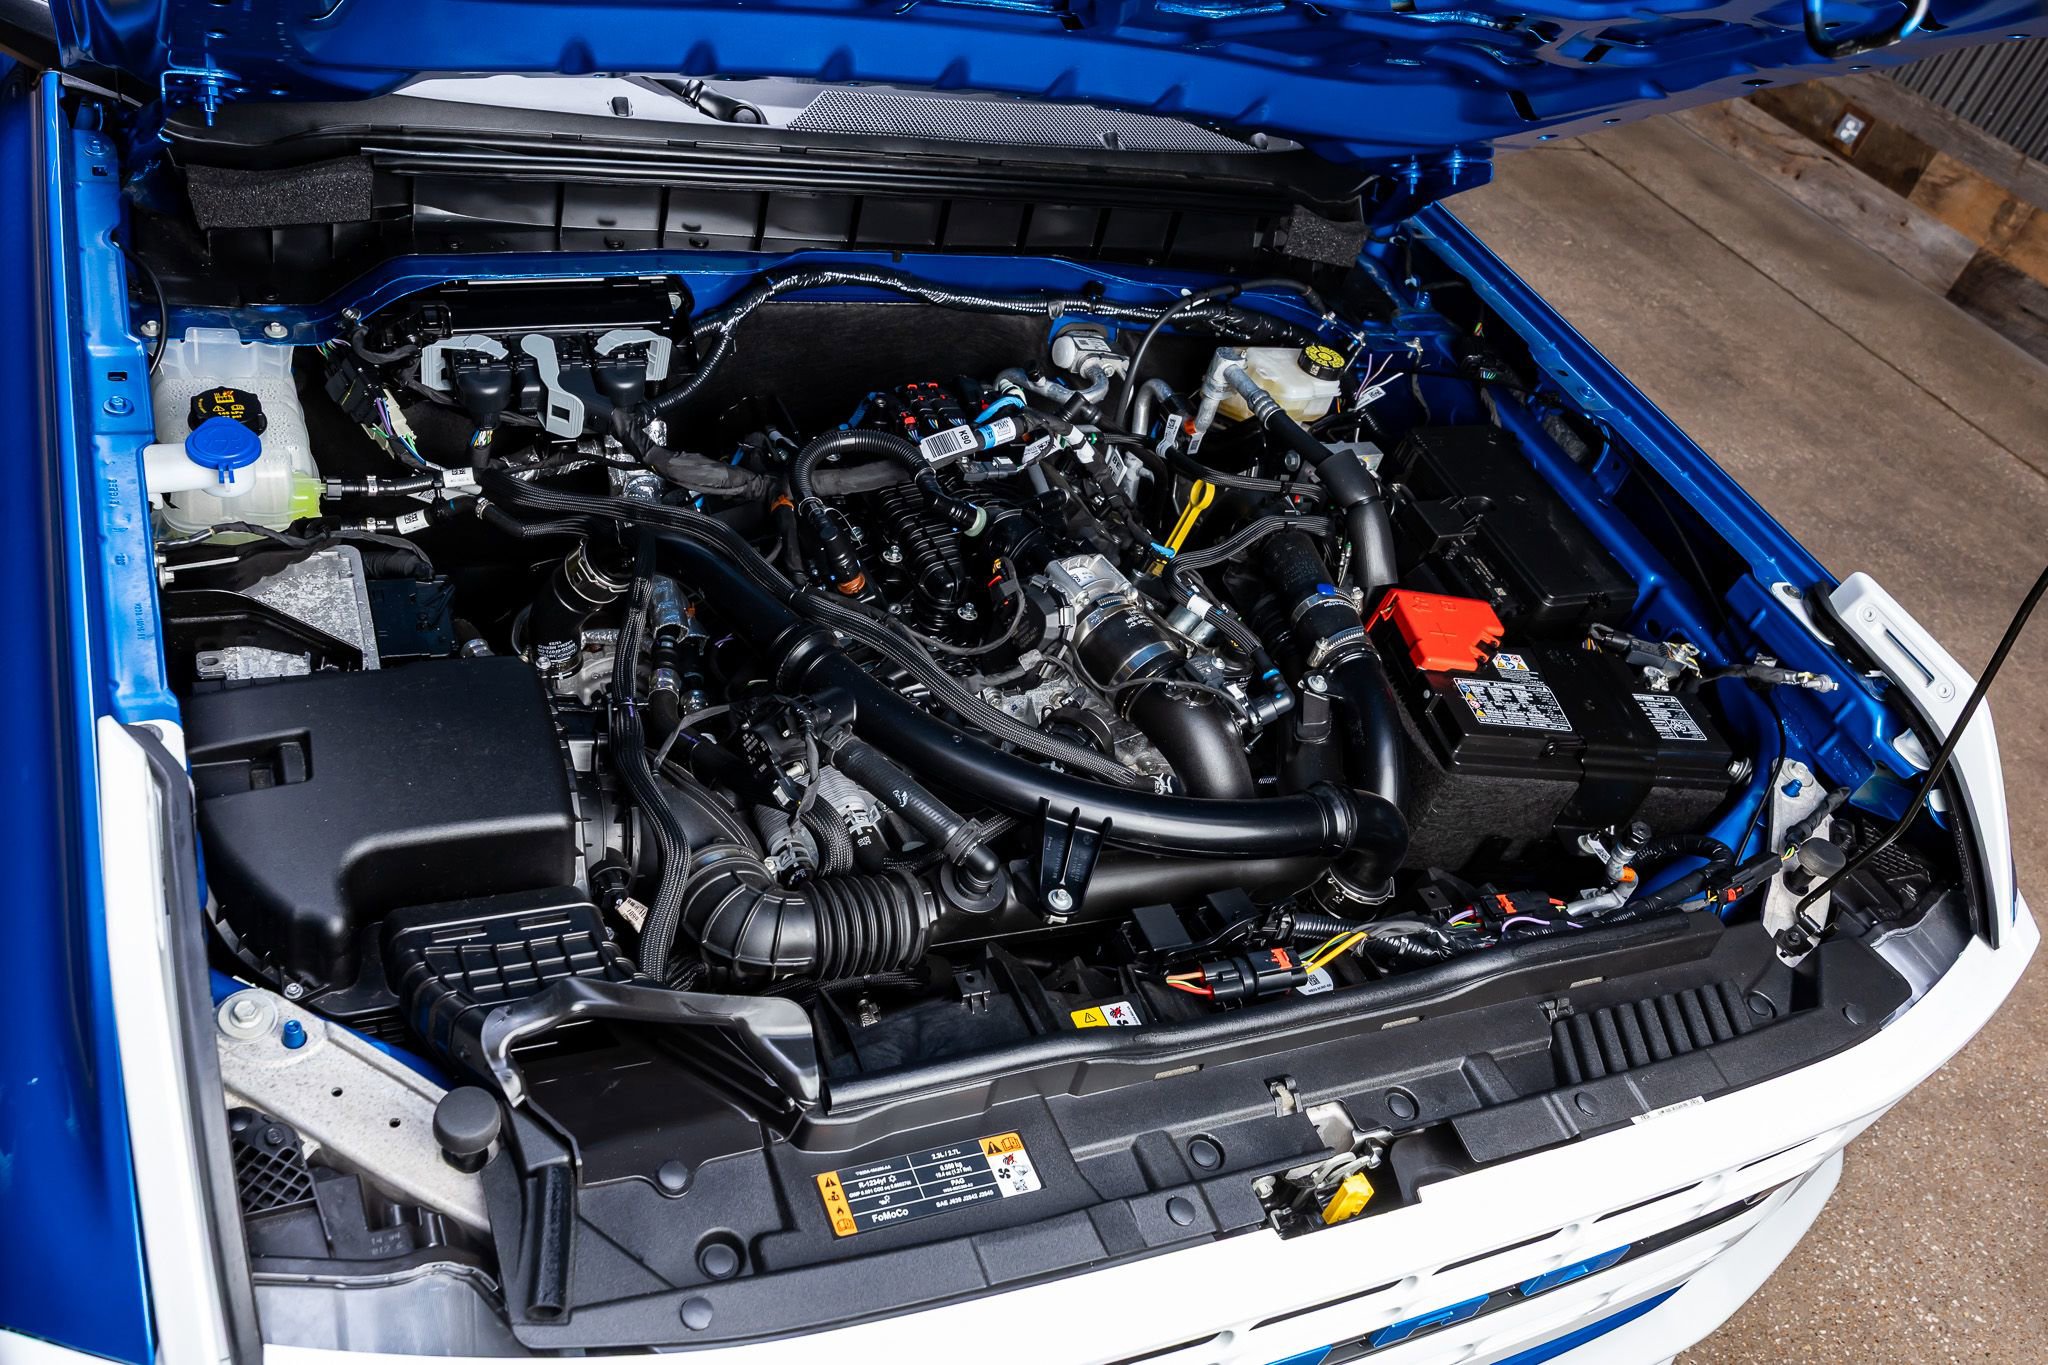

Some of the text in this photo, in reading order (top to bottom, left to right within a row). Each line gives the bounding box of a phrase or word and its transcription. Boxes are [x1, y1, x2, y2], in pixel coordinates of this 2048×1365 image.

[958, 430, 972, 445] K90
[858, 1177, 886, 1188] R-1234yf
[950, 1178, 965, 1186] PAG
[872, 1208, 909, 1223] FoMoCo
